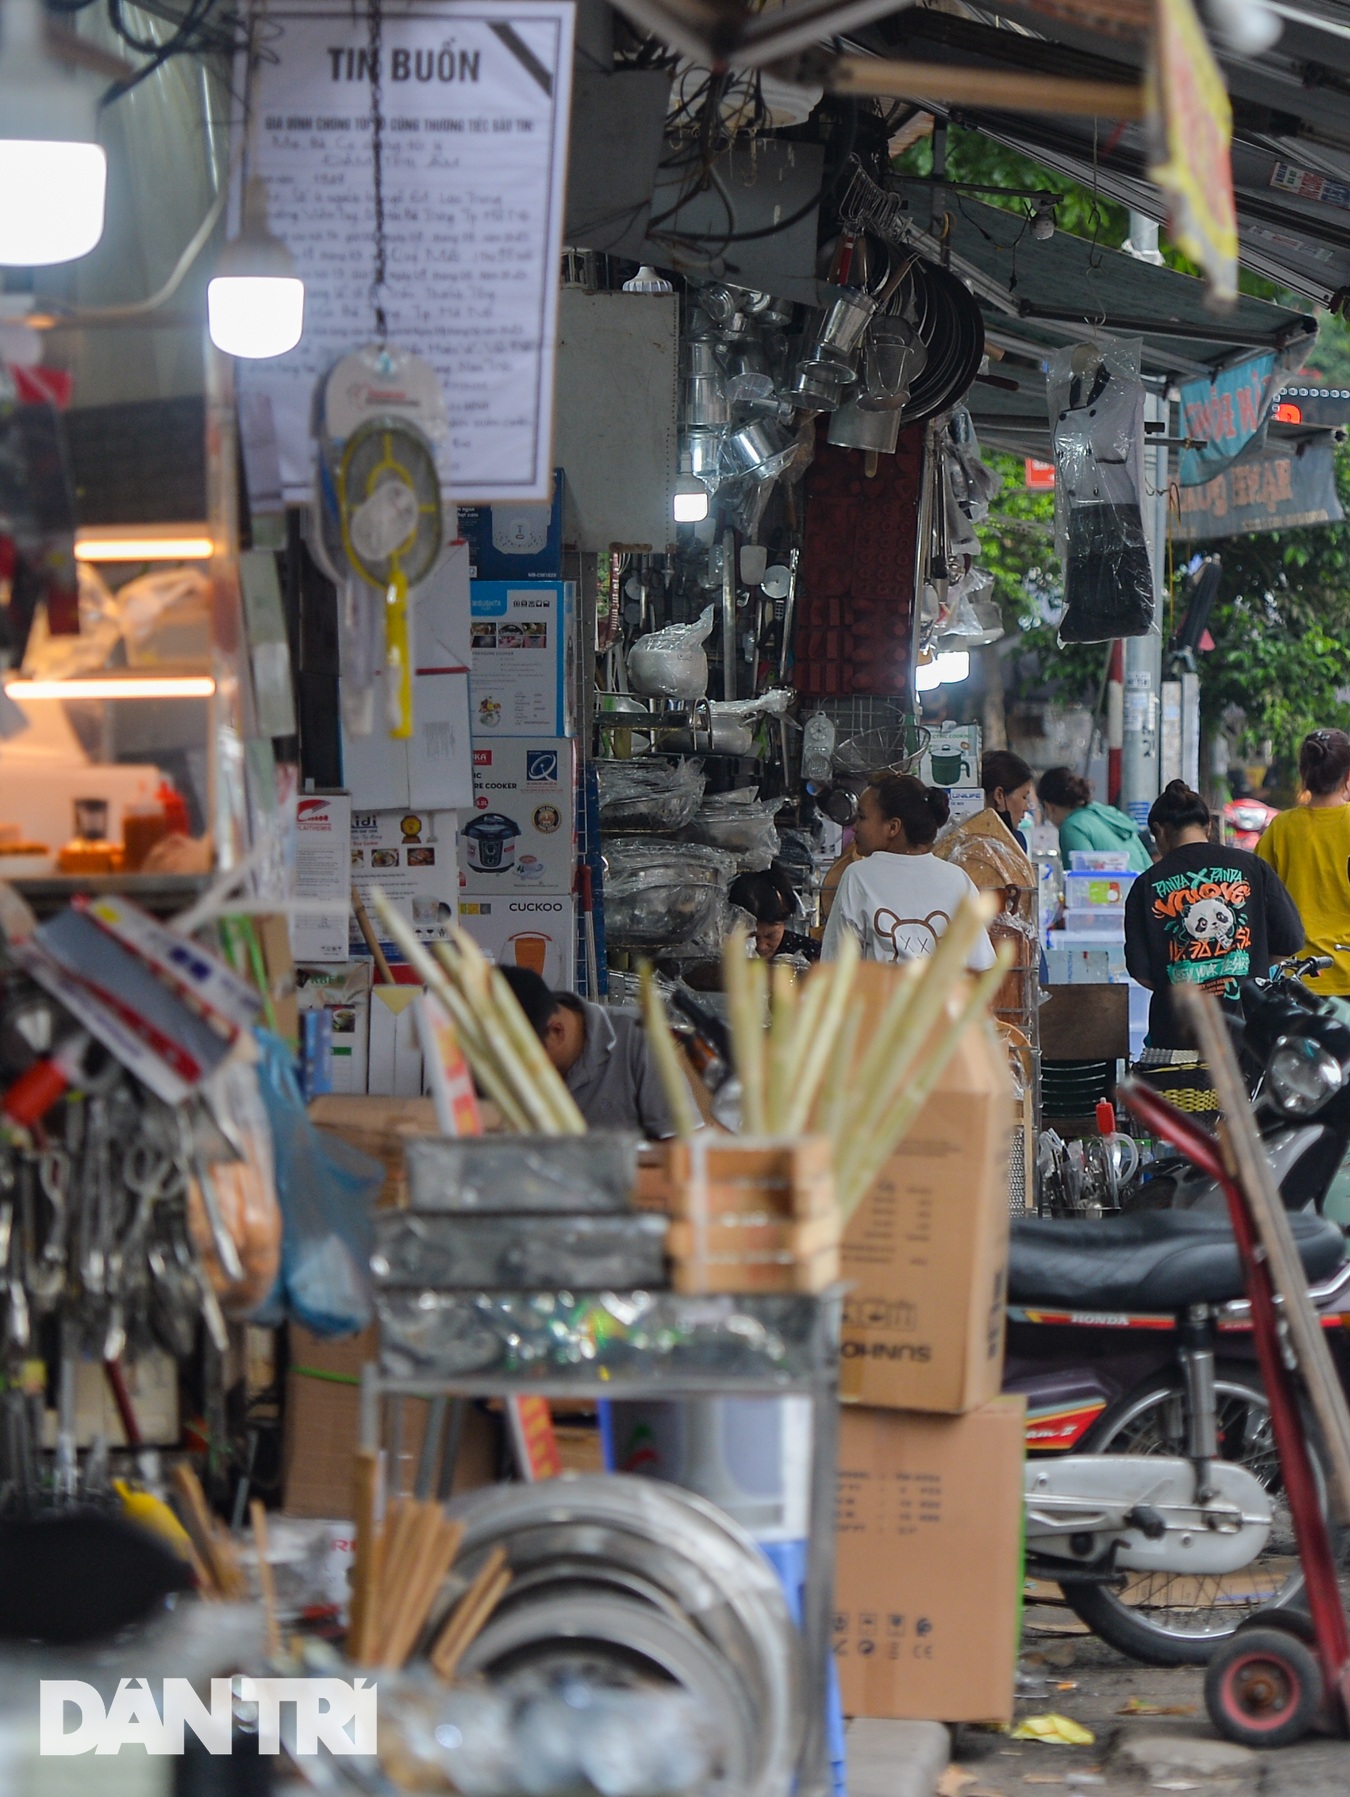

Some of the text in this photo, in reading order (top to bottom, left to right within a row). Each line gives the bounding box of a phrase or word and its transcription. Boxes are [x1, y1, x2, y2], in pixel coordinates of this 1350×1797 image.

[327, 46, 379, 81] TIN
[509, 902, 562, 912] CUCKOO
[1071, 1314, 1130, 1326] HONDA
